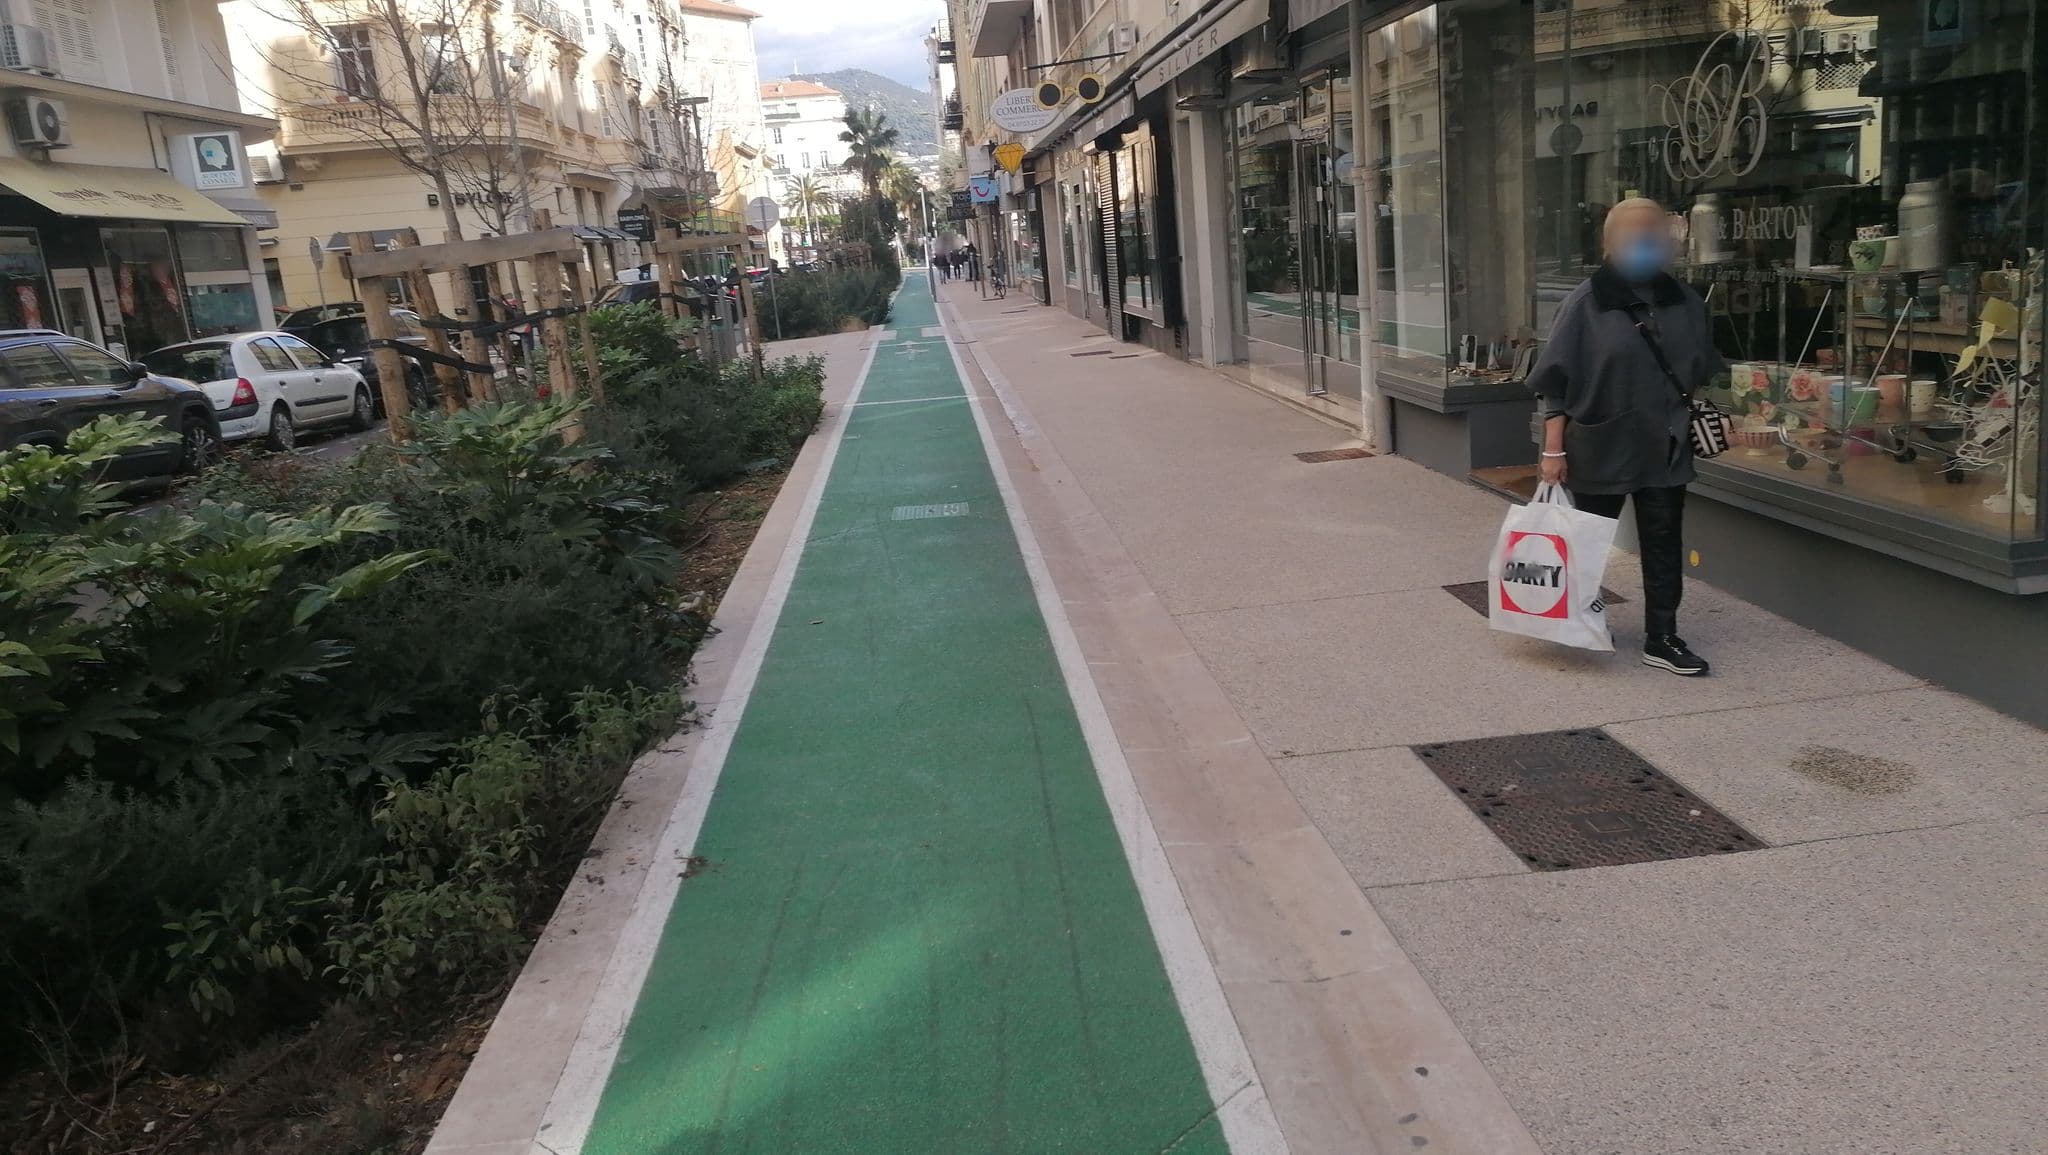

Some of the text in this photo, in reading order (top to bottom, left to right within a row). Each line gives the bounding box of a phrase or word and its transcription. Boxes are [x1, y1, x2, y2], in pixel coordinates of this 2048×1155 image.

[1159, 28, 1218, 82] SILVER
[996, 104, 1043, 116] COMMERC
[1006, 95, 1036, 106] LIBERT
[1732, 205, 1814, 240] BARTON
